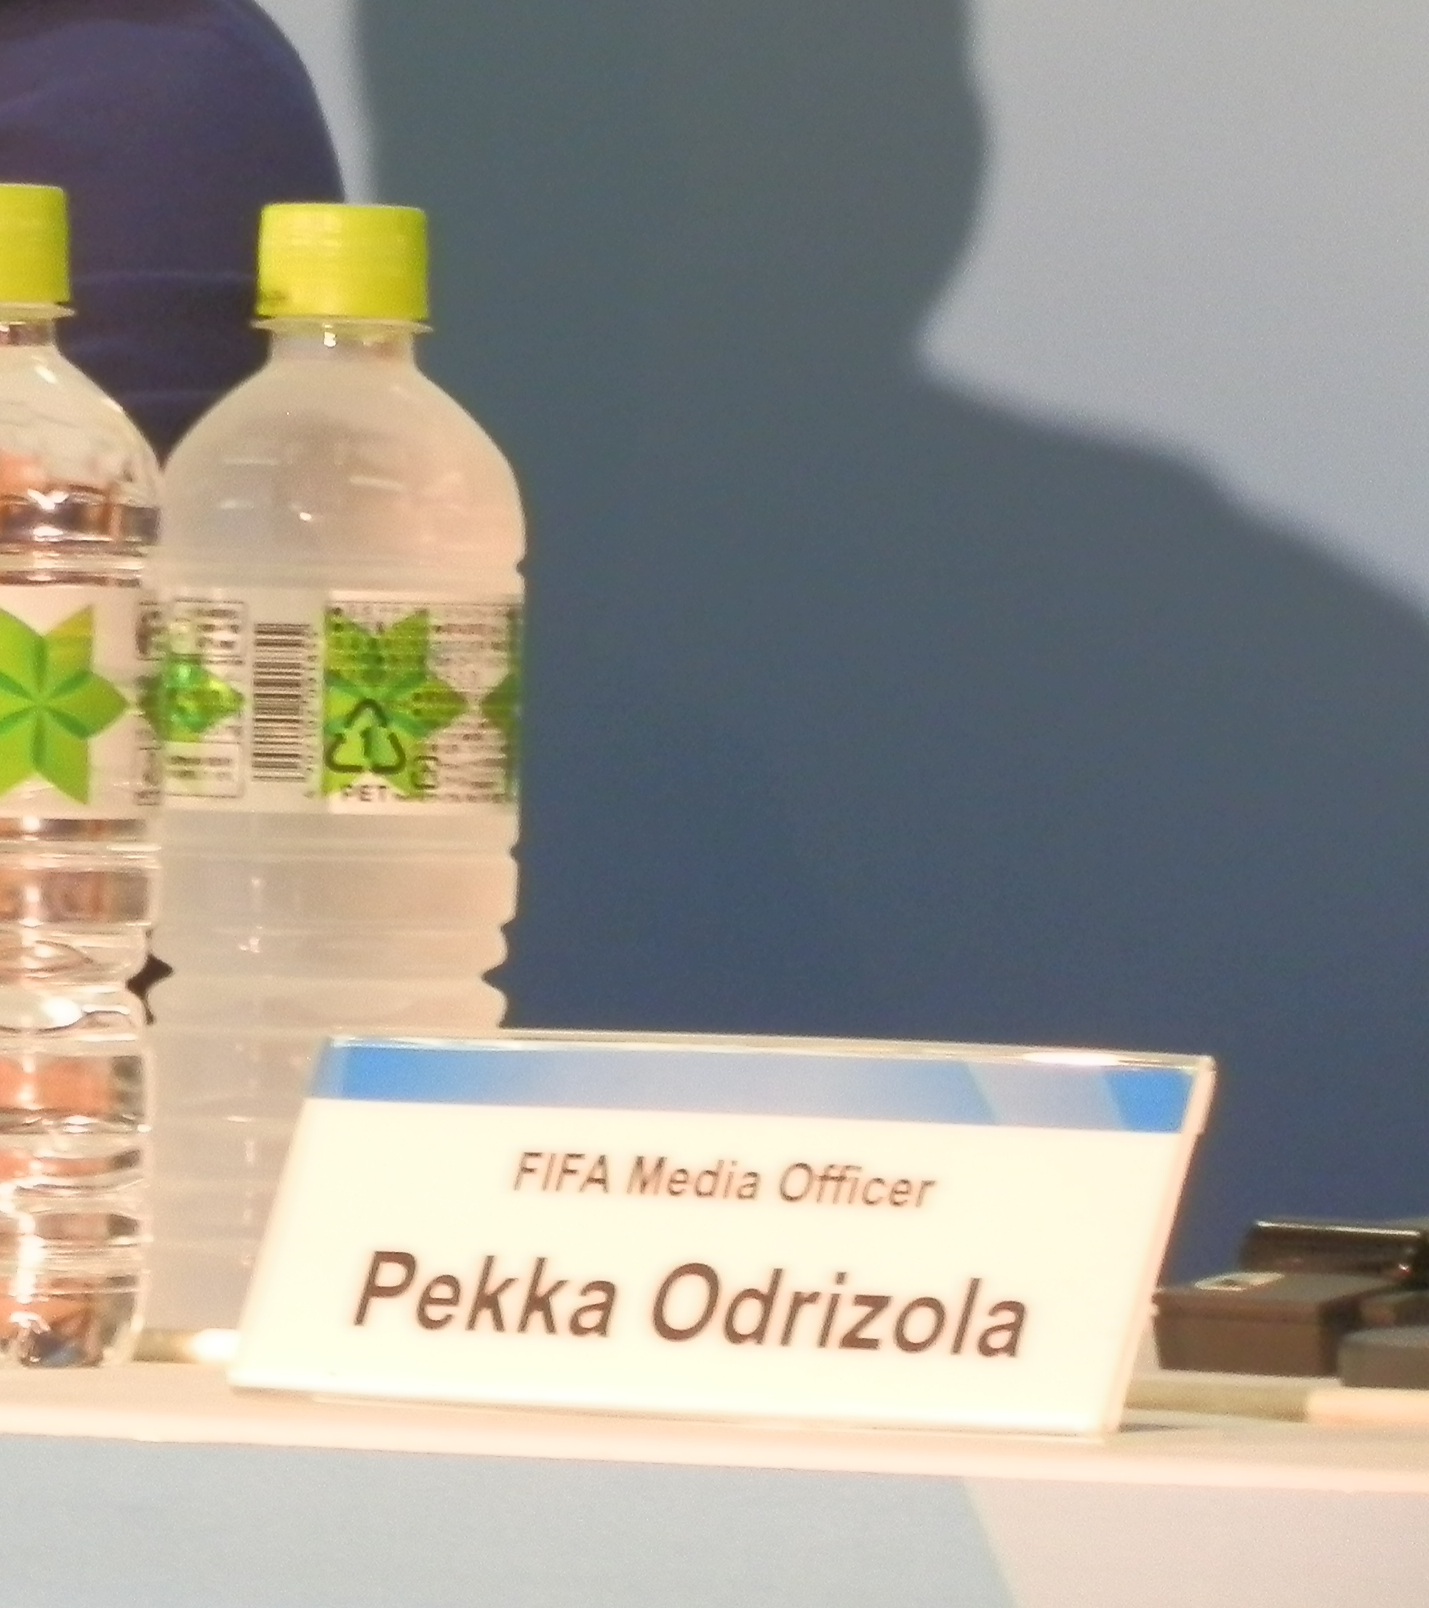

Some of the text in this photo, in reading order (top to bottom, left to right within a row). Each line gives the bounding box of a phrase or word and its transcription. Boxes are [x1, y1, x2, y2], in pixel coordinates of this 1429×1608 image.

[512, 1150, 937, 1210] FIFA Media Officer
[354, 1248, 1029, 1359] Pekka Odrizola
